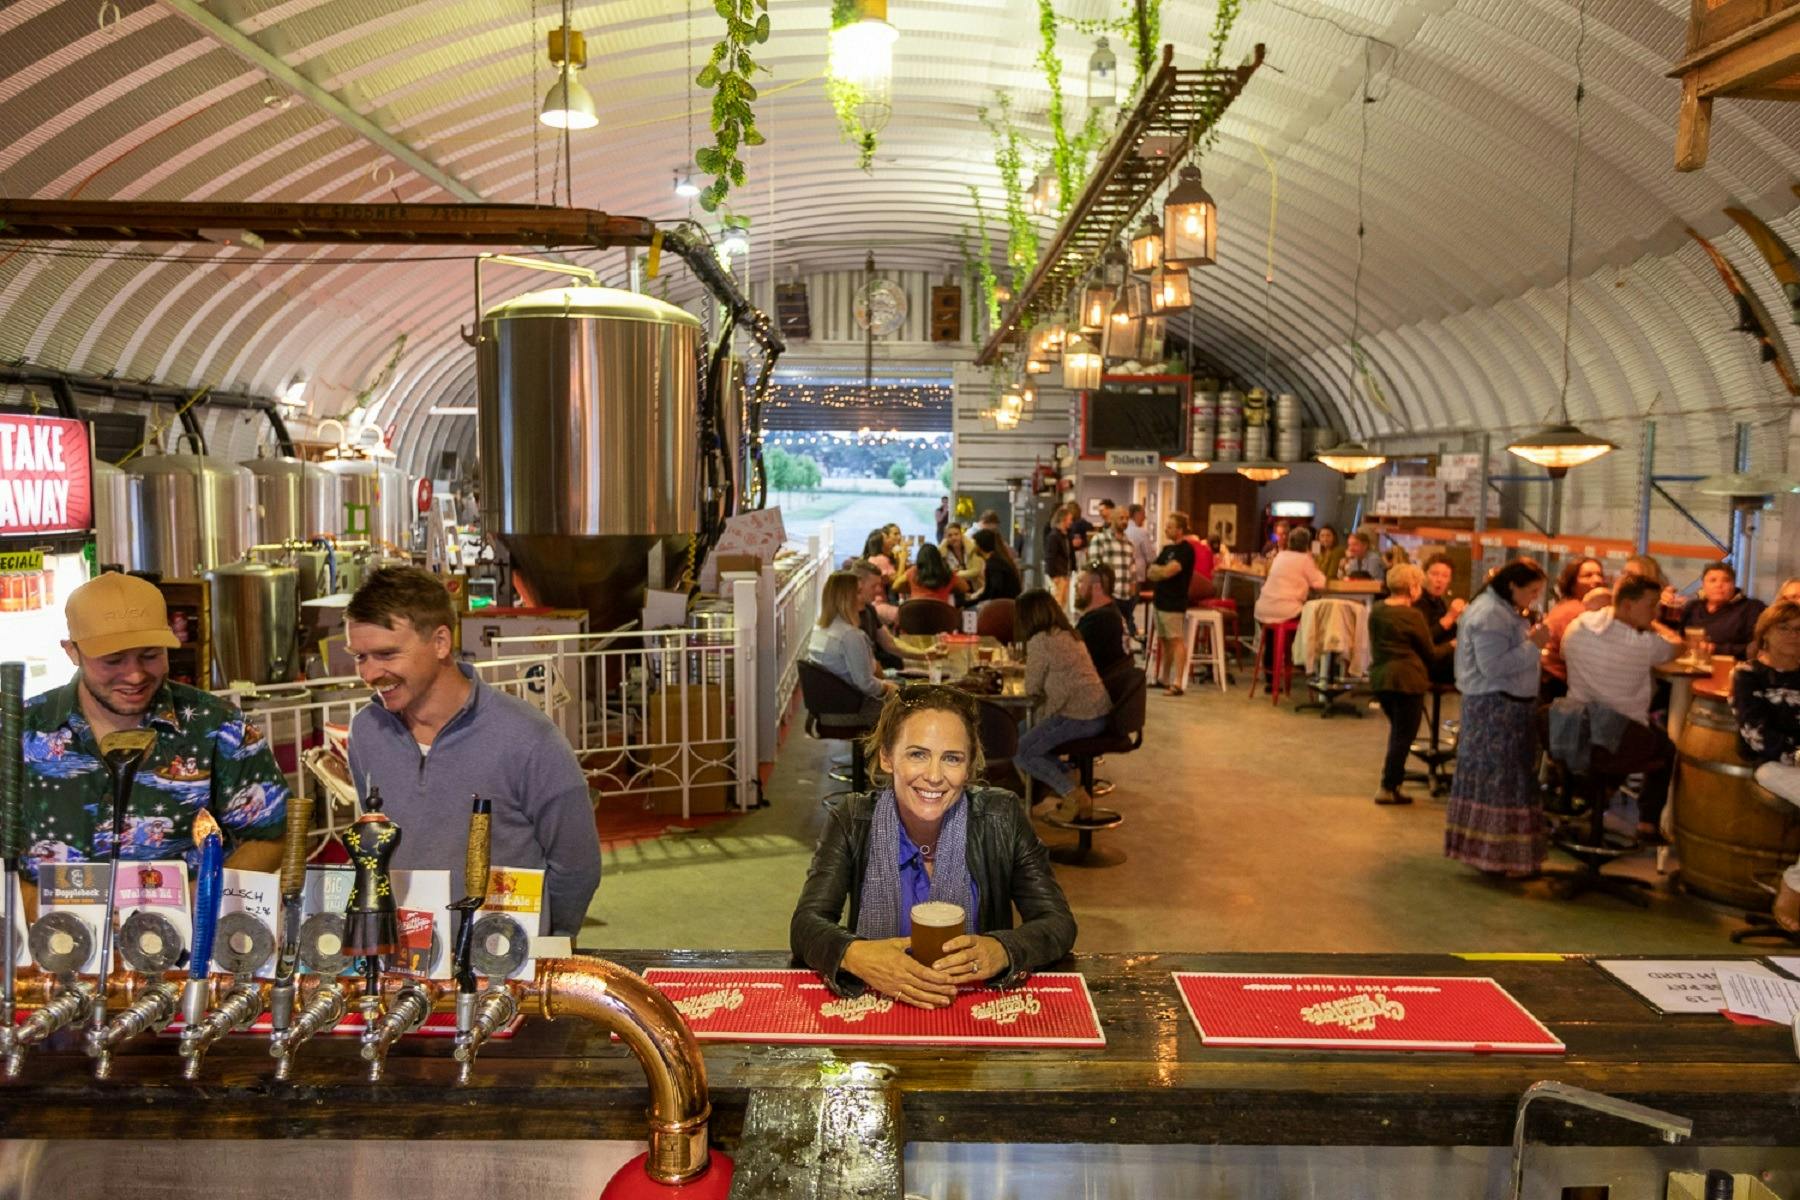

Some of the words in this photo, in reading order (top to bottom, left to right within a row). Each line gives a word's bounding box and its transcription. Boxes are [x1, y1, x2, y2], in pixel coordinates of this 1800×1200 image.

[0, 423, 66, 471] TAKE
[1111, 454, 1145, 465] Toilets
[0, 479, 70, 527] AWAY
[0, 554, 39, 570] ECIAL!
[223, 888, 264, 902] OLSCH
